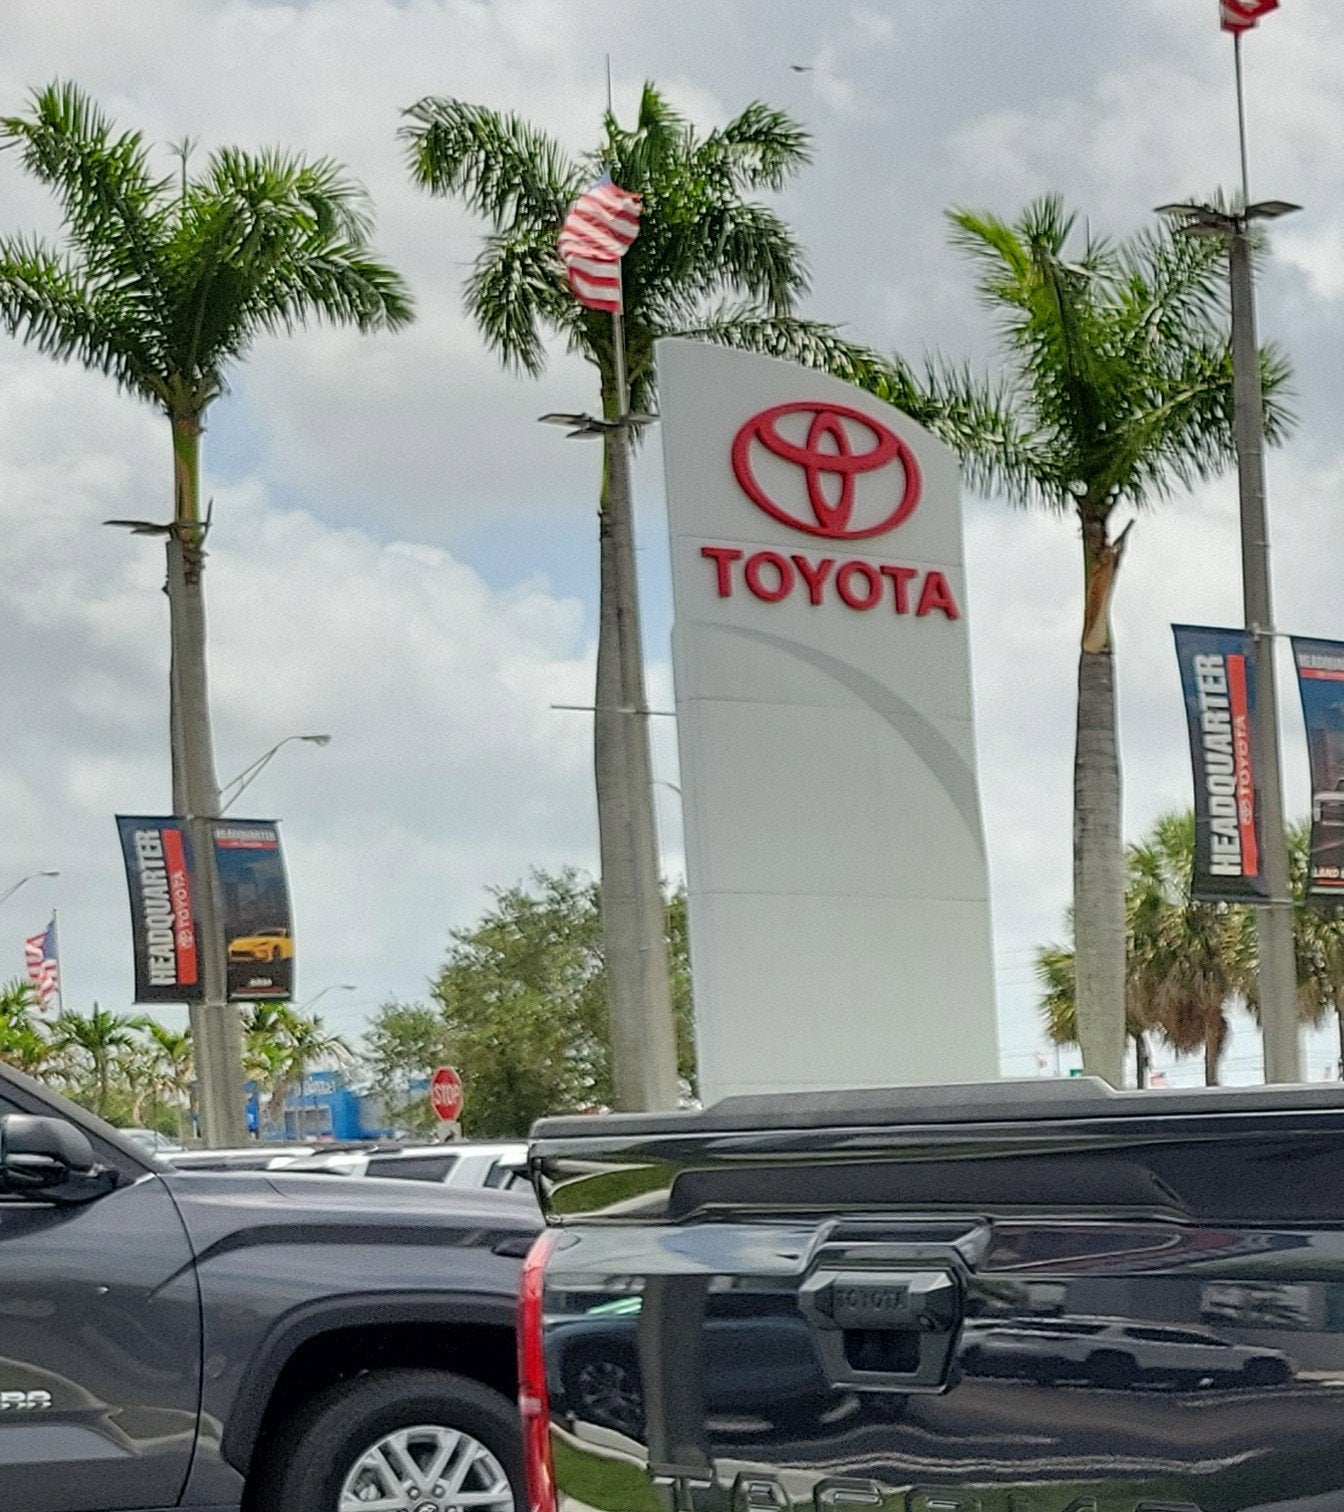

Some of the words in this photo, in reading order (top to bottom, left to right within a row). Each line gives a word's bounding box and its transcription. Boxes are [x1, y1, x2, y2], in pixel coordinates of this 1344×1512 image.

[700, 546, 961, 621] TOYOTA
[1195, 653, 1242, 877] HEADQUARTER
[1235, 714, 1252, 796] TOYOTA
[134, 828, 177, 987] HEADQUARTER
[171, 870, 193, 930] TOYOTA
[433, 1083, 460, 1105] STOP
